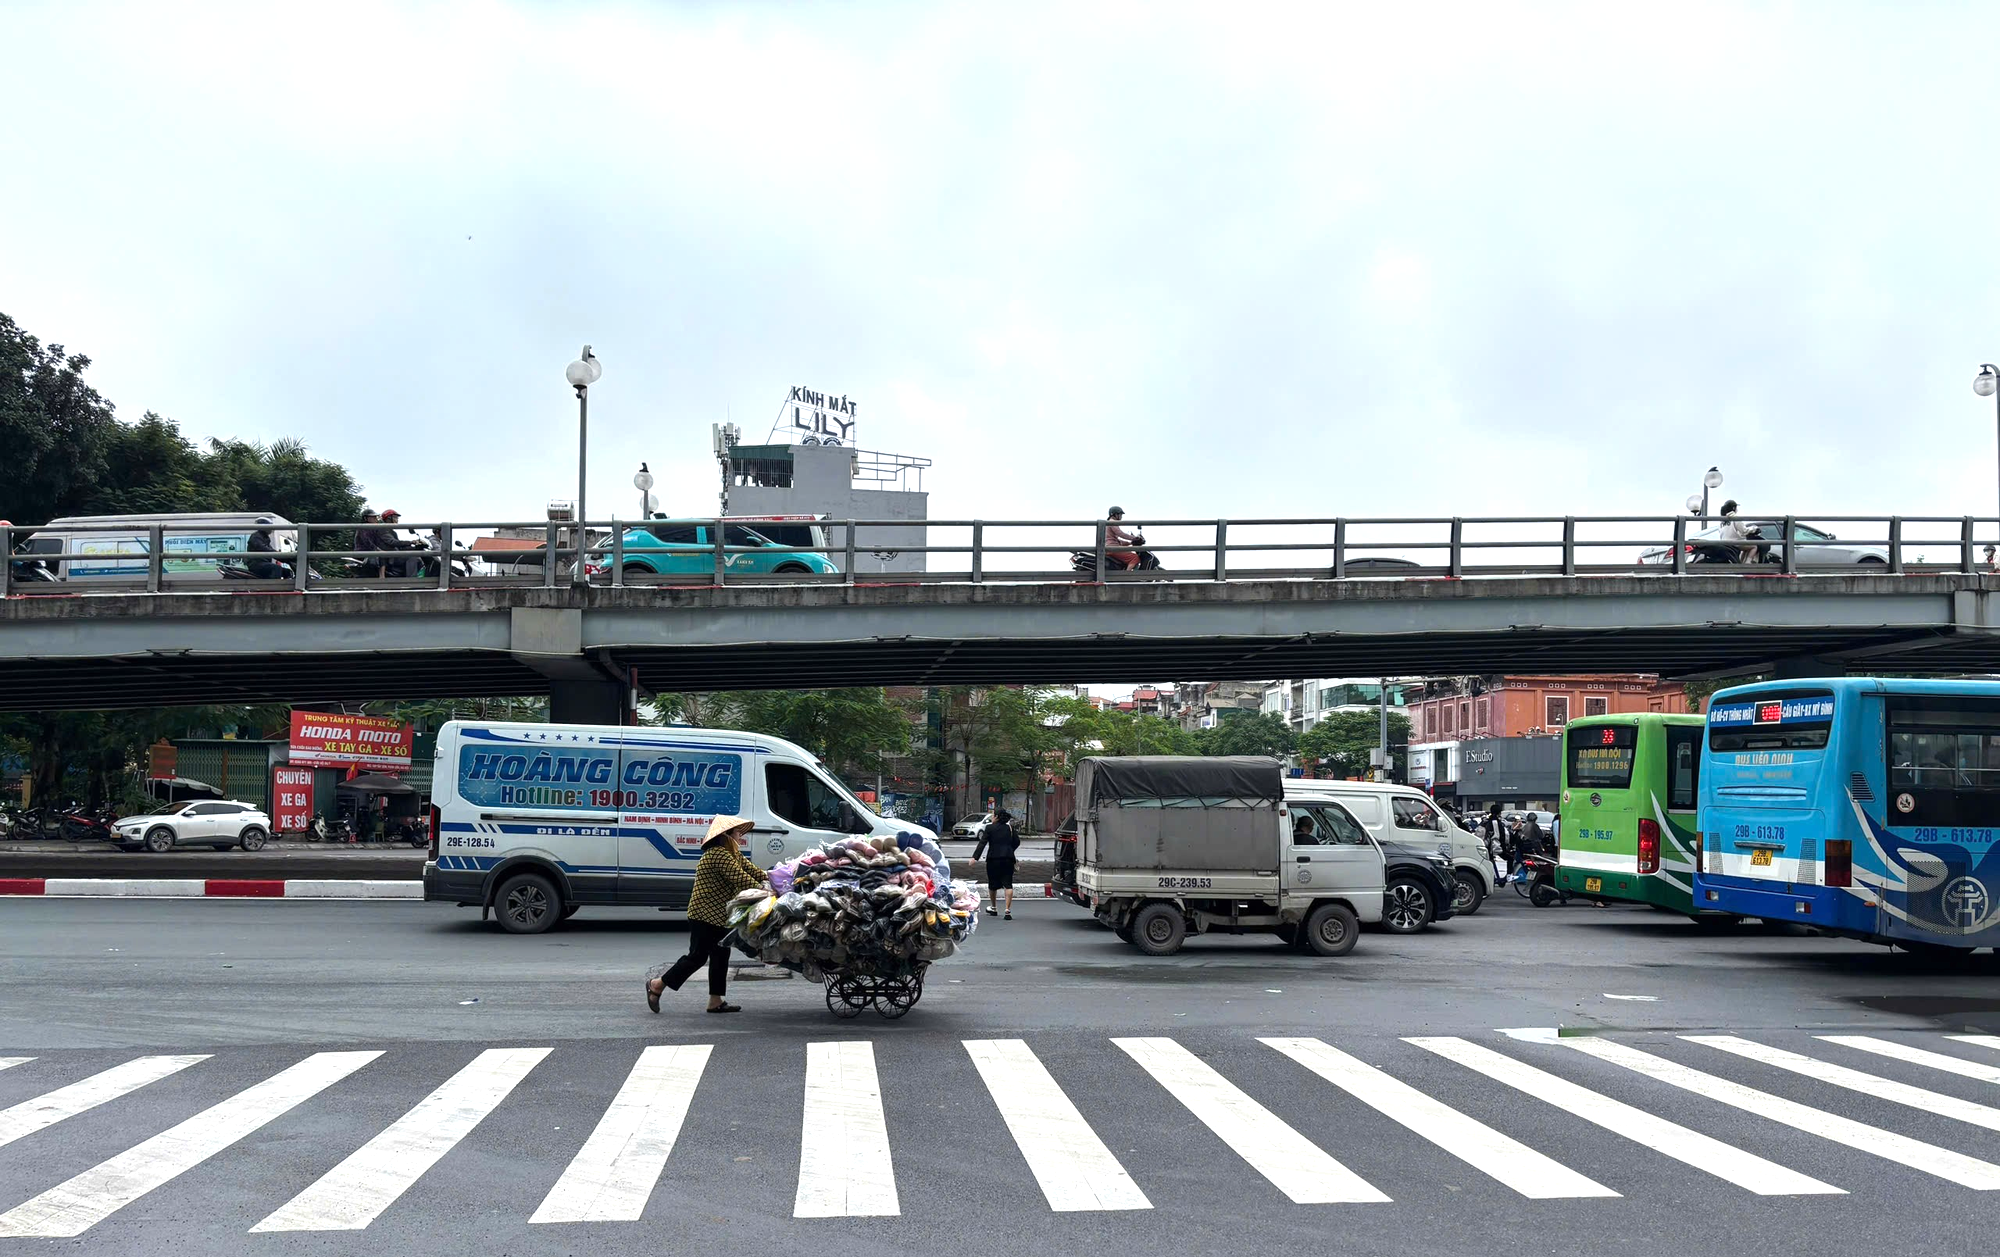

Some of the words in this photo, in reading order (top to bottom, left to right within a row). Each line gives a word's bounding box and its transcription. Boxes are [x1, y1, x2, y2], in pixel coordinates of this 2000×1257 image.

[792, 386, 824, 407] KÍNH
[829, 394, 856, 414] MẮT
[795, 407, 854, 439] LILY
[305, 714, 328, 722] TRUNG
[330, 716, 344, 724] TÂM
[345, 716, 355, 724] KỸ
[300, 726, 352, 740] HONDA
[358, 729, 401, 743] MOTO
[325, 742, 336, 751] XE
[340, 743, 356, 752] TAY
[359, 744, 372, 754] GA
[381, 746, 392, 755] XE
[394, 744, 407, 756] SỐ
[276, 769, 312, 784] CHUYÊN
[468, 750, 614, 784] HOÀNG
[623, 756, 732, 789] CÔNG
[281, 793, 293, 806] XE
[295, 793, 307, 806] GA
[501, 786, 583, 806] Hotline:
[589, 789, 695, 810] 1900.3292
[281, 815, 293, 828] XE
[295, 810, 307, 828] SỐ
[1735, 825, 1750, 837] 29B
[1757, 826, 1784, 840] 613.78
[1914, 828, 1938, 842] 29B
[1951, 829, 1992, 843] 613.78
[447, 836, 495, 848] 29E-128.54
[1158, 877, 1212, 888] 29C-239.53
